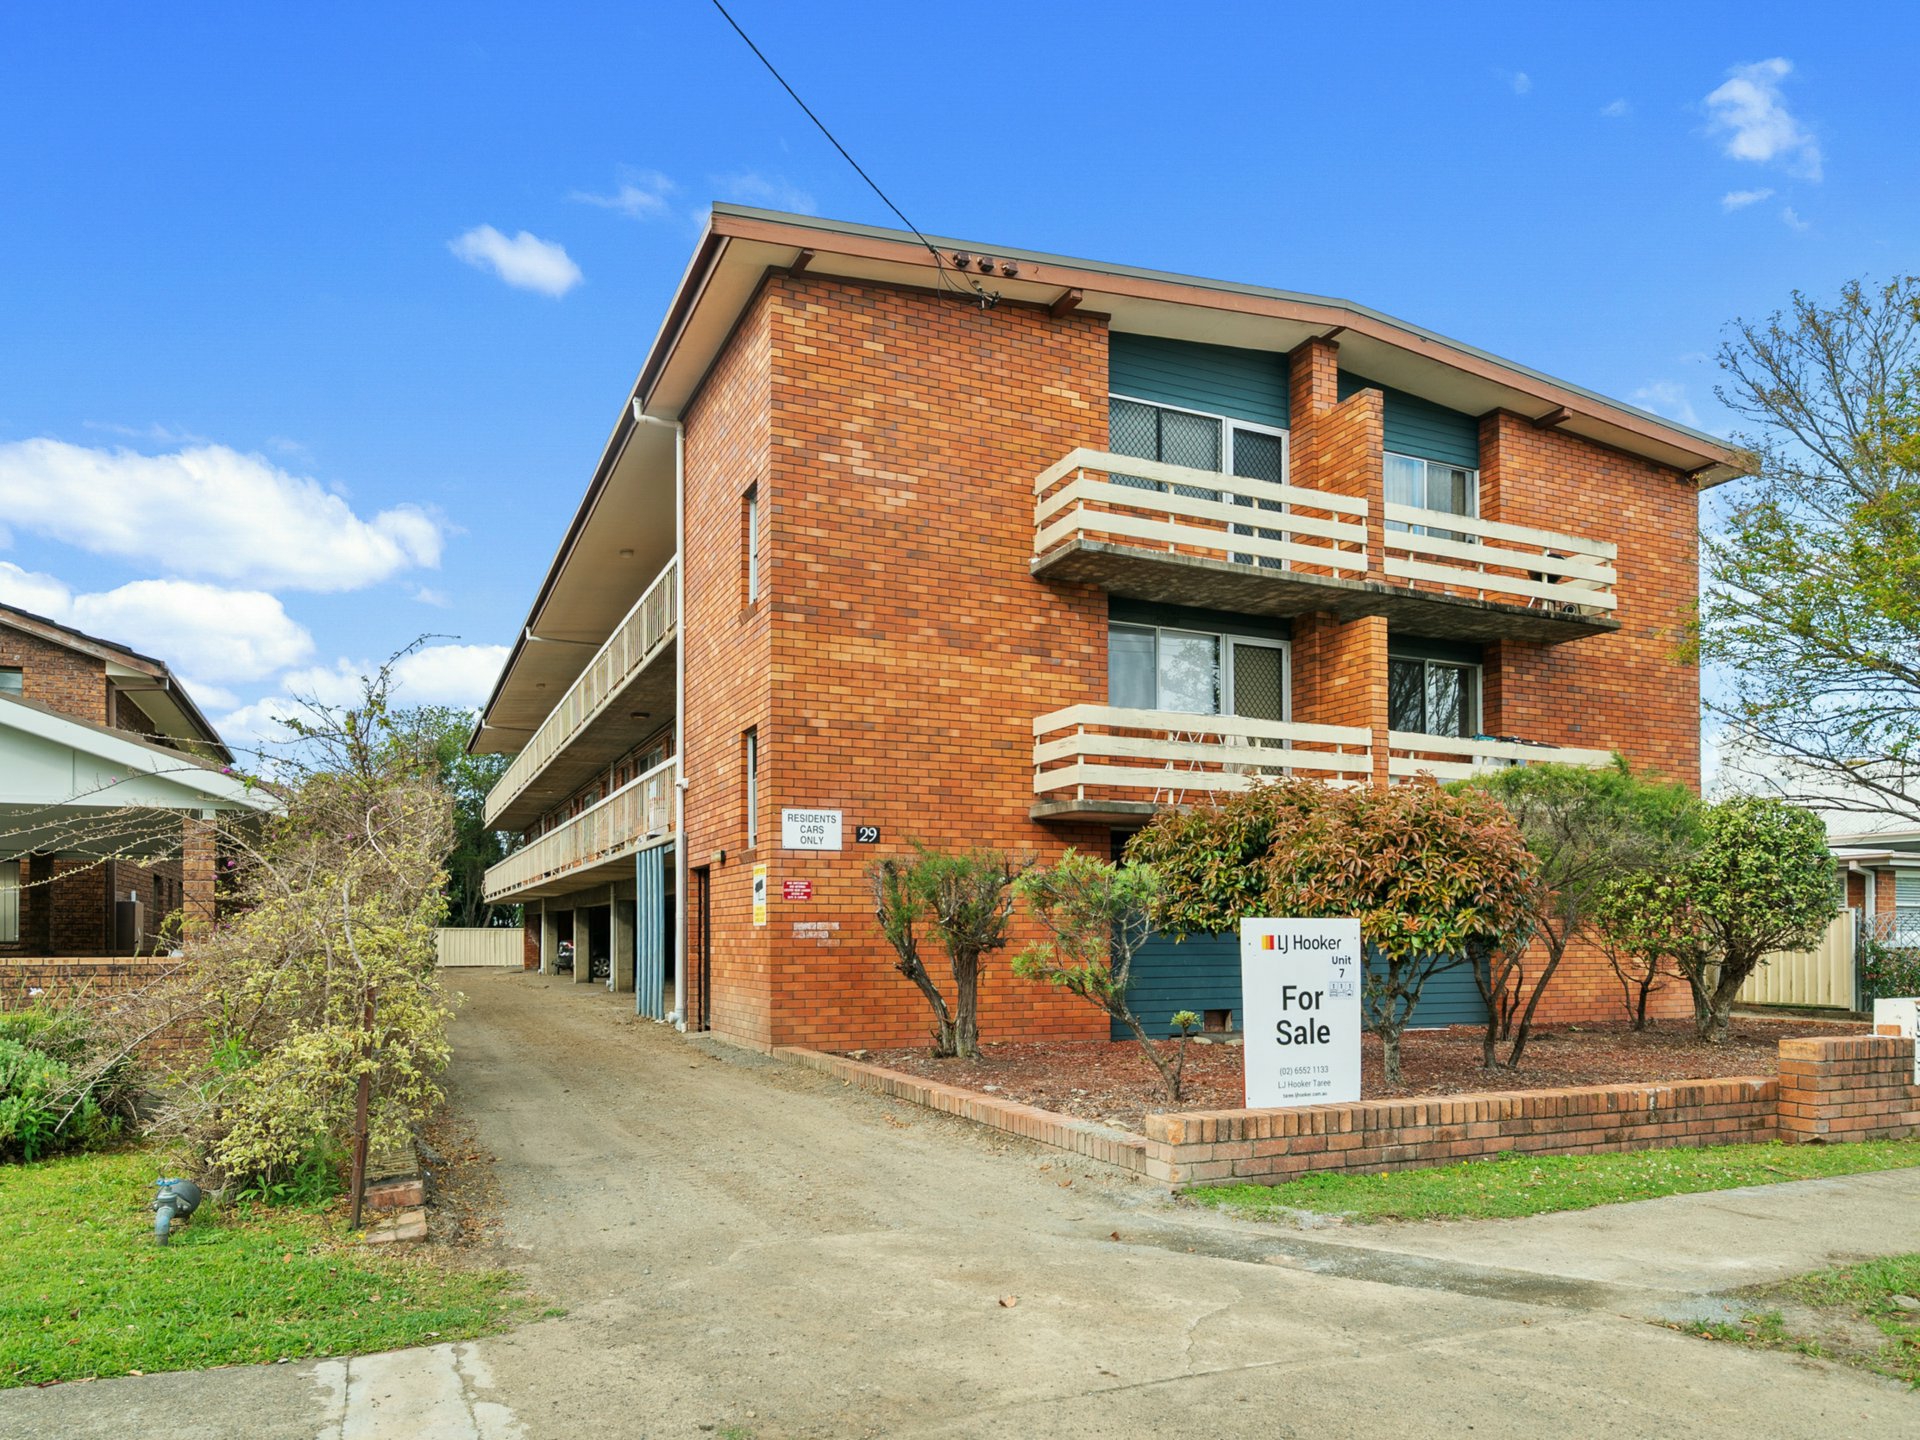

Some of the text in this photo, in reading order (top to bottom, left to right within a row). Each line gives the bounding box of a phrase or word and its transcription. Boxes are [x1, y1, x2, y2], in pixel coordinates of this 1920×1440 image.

[787, 813, 837, 824] RESIDENTS
[799, 824, 825, 834] CARS
[858, 826, 878, 843] 29
[799, 835, 824, 845] ONLY
[1277, 934, 1342, 955] LJ Hooker
[1331, 954, 1352, 965] Unit
[1339, 968, 1345, 978] 7
[1282, 985, 1324, 1011] For
[1276, 1017, 1331, 1046] Sale
[1279, 1065, 1329, 1077] (02) 6552 1133
[1287, 1080, 1311, 1088] Hooker
[1312, 1079, 1331, 1087] Taree
